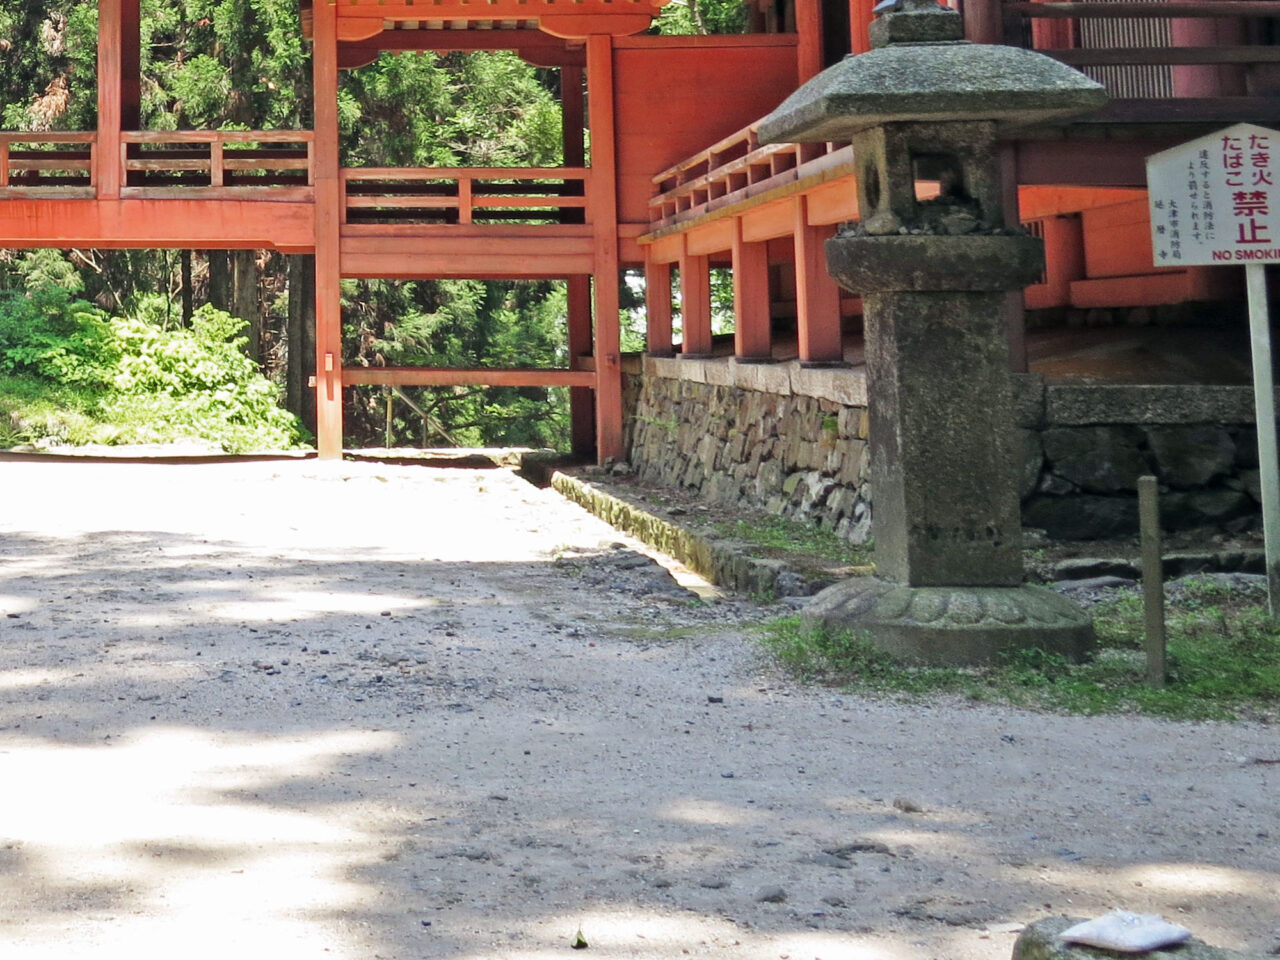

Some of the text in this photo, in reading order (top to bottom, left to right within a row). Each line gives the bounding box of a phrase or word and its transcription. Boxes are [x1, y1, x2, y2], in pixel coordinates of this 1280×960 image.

[1221, 136, 1244, 187] たばこ
[1248, 134, 1273, 186] たき火
[1232, 190, 1272, 244] 禁止
[1212, 250, 1232, 260] NO
